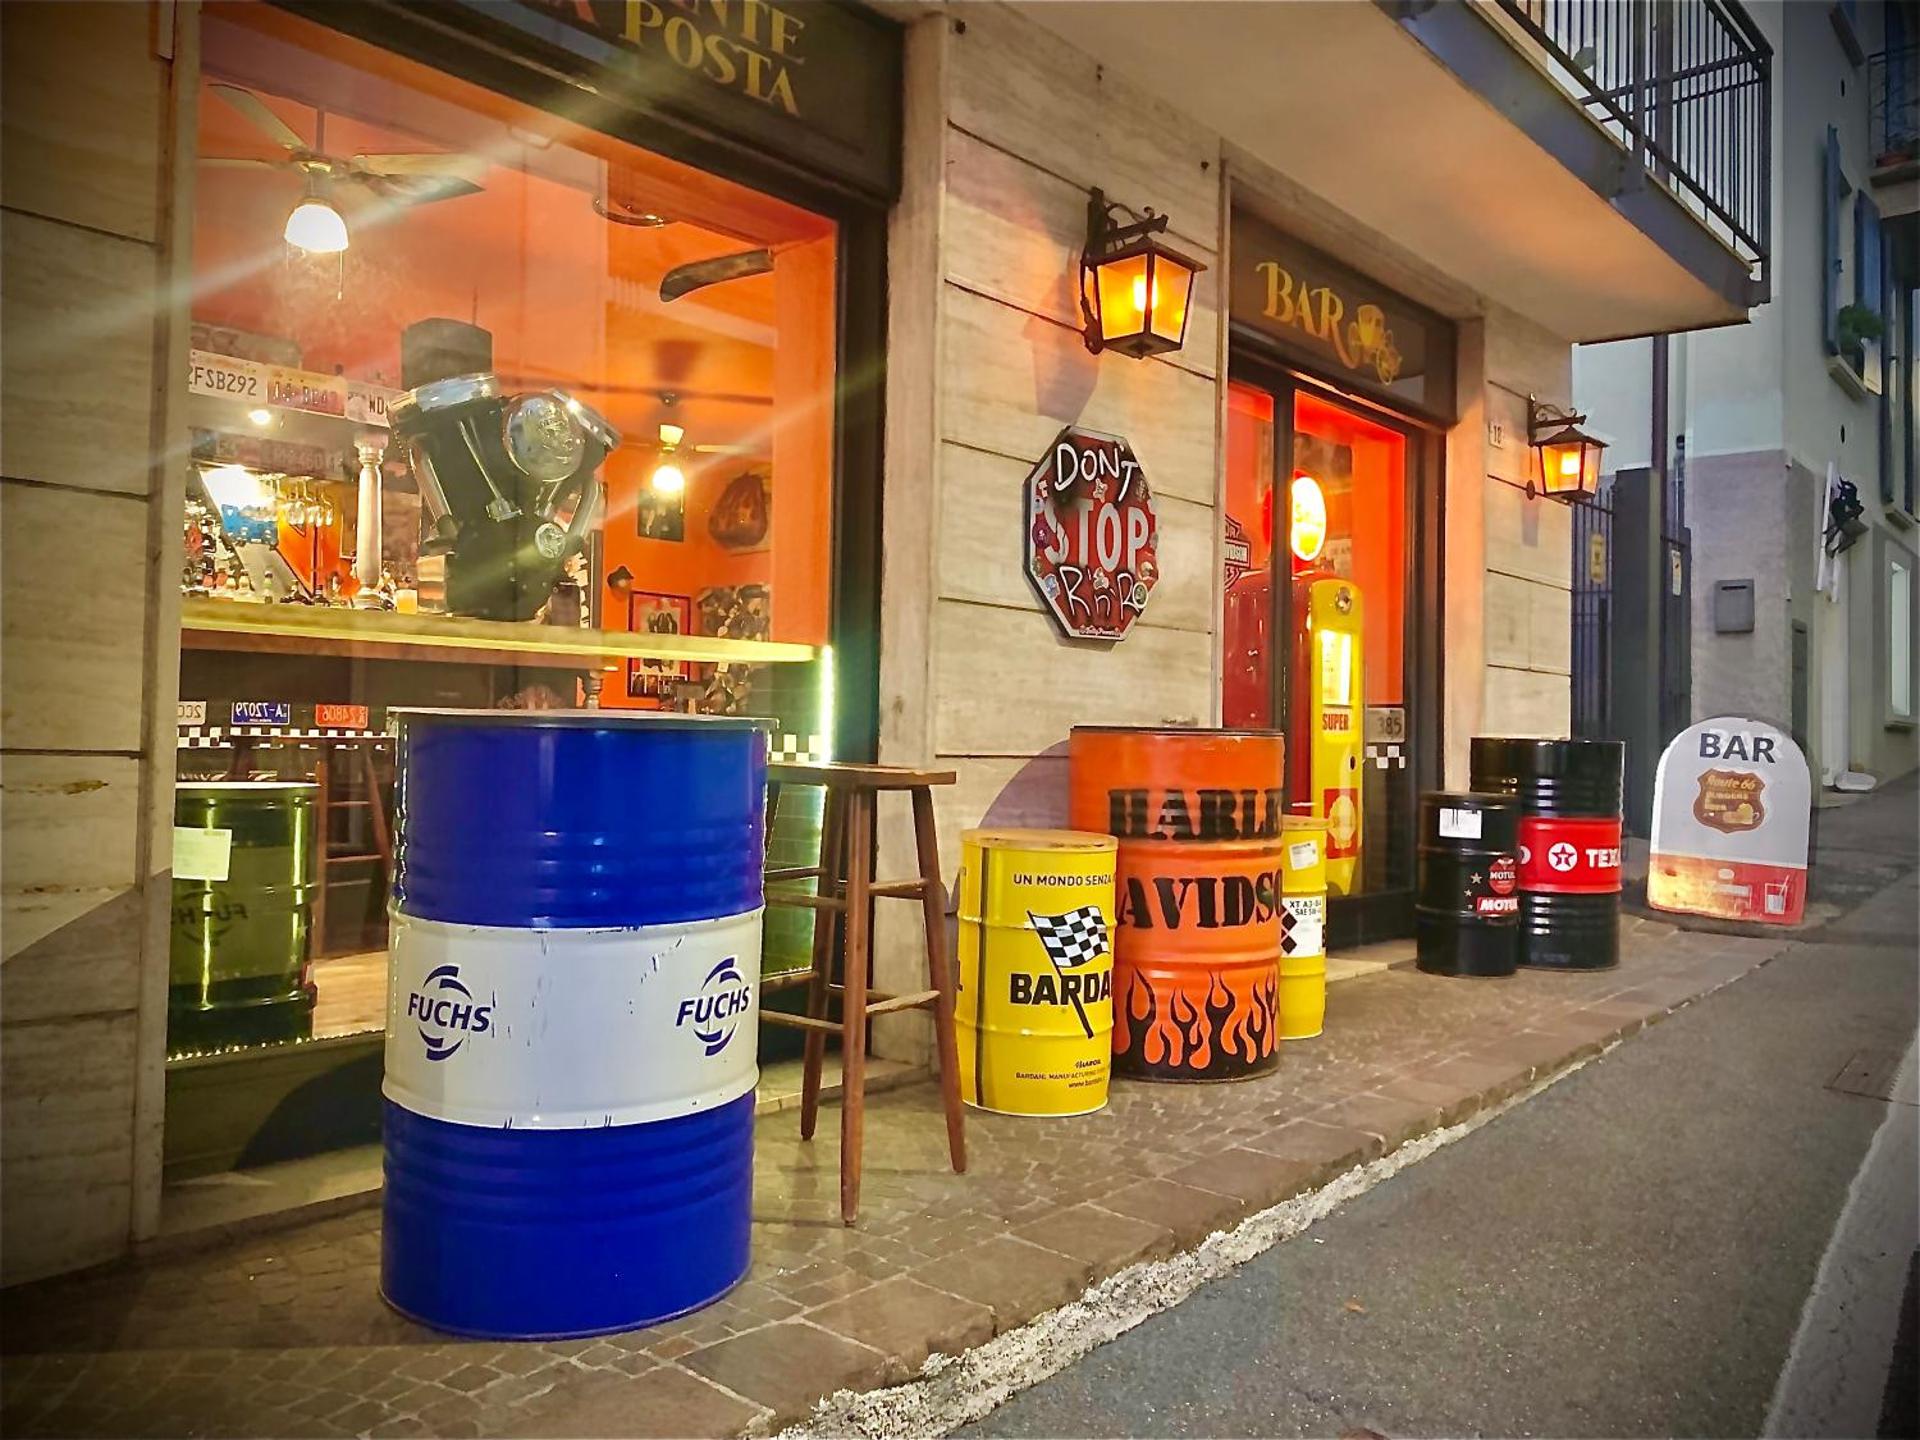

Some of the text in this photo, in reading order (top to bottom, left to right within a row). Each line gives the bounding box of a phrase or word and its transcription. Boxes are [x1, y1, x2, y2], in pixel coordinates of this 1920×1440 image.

[618, 0, 800, 117] POSTA
[1255, 261, 1362, 369] BAR
[189, 366, 258, 397] FSB292
[1043, 496, 1149, 575] STOP
[1322, 713, 1350, 731] SUPER
[1699, 732, 1776, 764] BAR
[1013, 873, 1112, 886] UN MONDO SENZA
[1113, 868, 1284, 929] AVIDS
[407, 992, 491, 1033] FUCHS
[675, 984, 750, 1027] FUCHS
